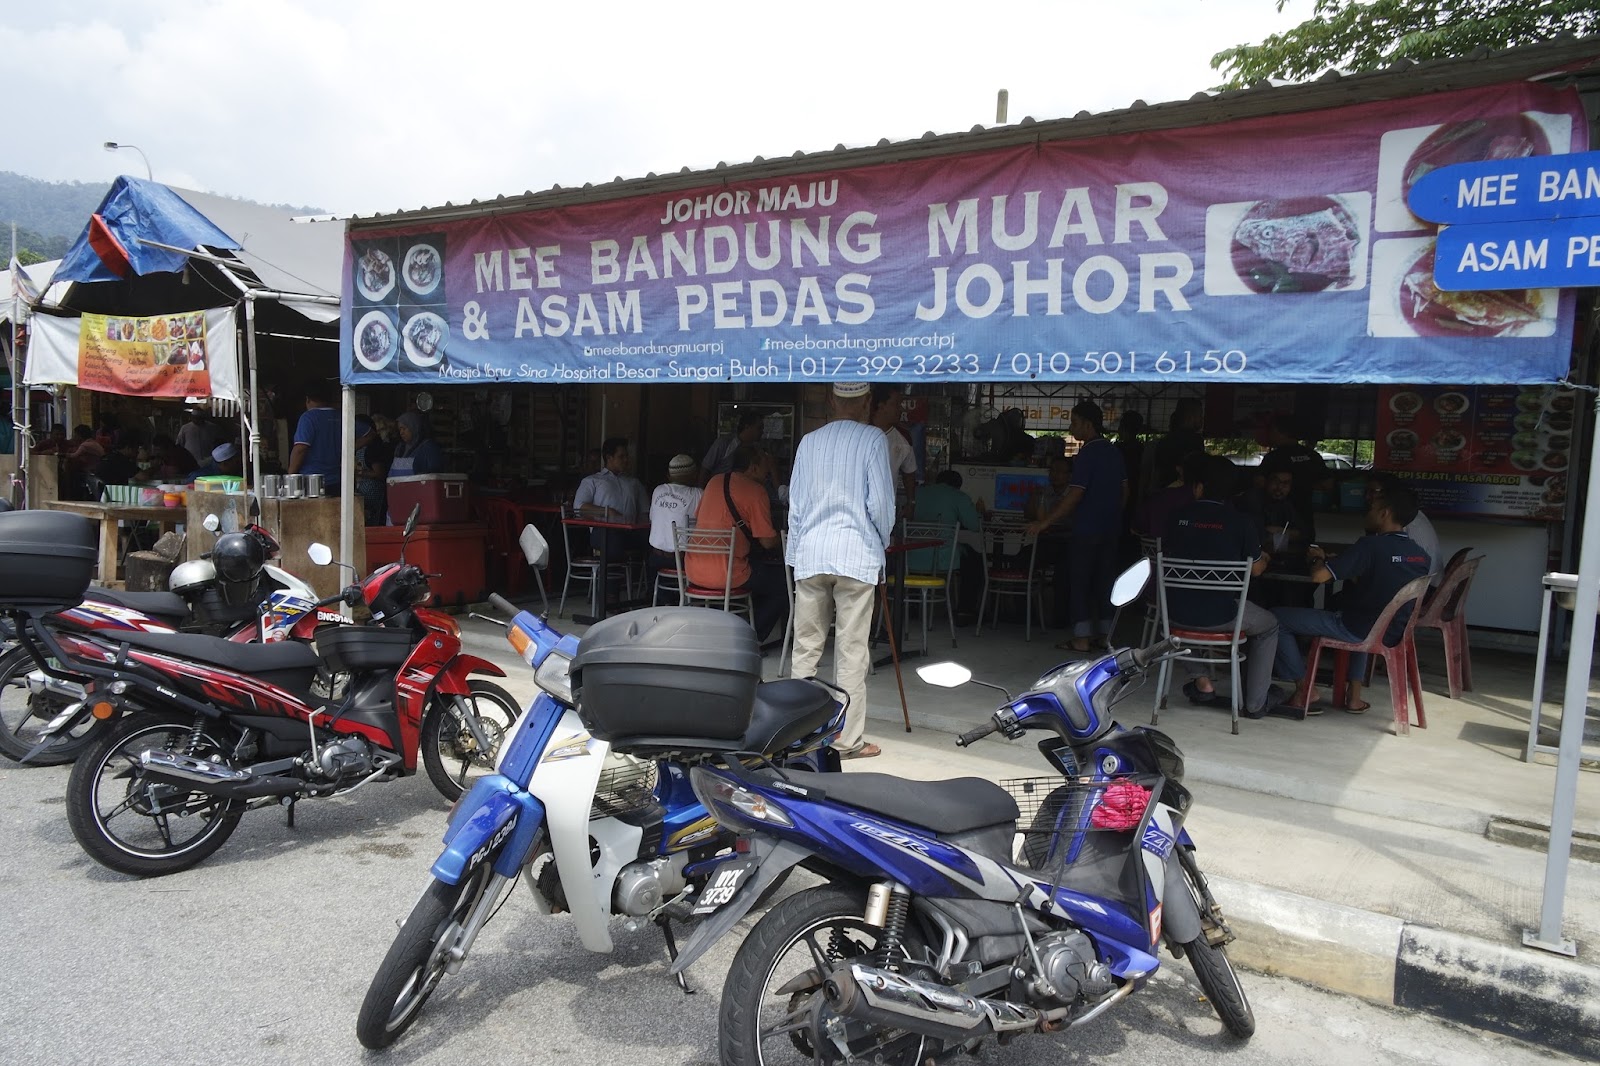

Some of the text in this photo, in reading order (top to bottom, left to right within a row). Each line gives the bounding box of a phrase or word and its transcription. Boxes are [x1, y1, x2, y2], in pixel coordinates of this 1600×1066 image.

[661, 179, 839, 225] JOHOR MAJU
[1457, 167, 1600, 208] MEE BAN
[474, 182, 1168, 293] MEE BANDUNG MUAR
[1457, 236, 1600, 272] ASAM PE
[463, 252, 1193, 340] & ASAM PEDAS JOHOR
[592, 340, 724, 357] meebandungmuarpj
[439, 363, 482, 381] Masjid
[484, 362, 512, 378] Ibnu
[516, 363, 548, 379] Sina
[552, 362, 611, 381] Hospital
[616, 362, 662, 379] Besar
[667, 360, 724, 380] Sungai
[730, 356, 780, 378] Buloh
[801, 356, 847, 377] 017
[857, 355, 903, 376] 399
[913, 354, 980, 375] 3233
[1011, 352, 1071, 374] 010
[1080, 351, 1136, 374] 501
[1155, 350, 1247, 374] 6150
[1454, 474, 1484, 484] RASA
[1486, 475, 1520, 486] ABADI
[469, 840, 493, 871] PGJ
[714, 869, 744, 887] WYX
[700, 886, 736, 905] 3739
